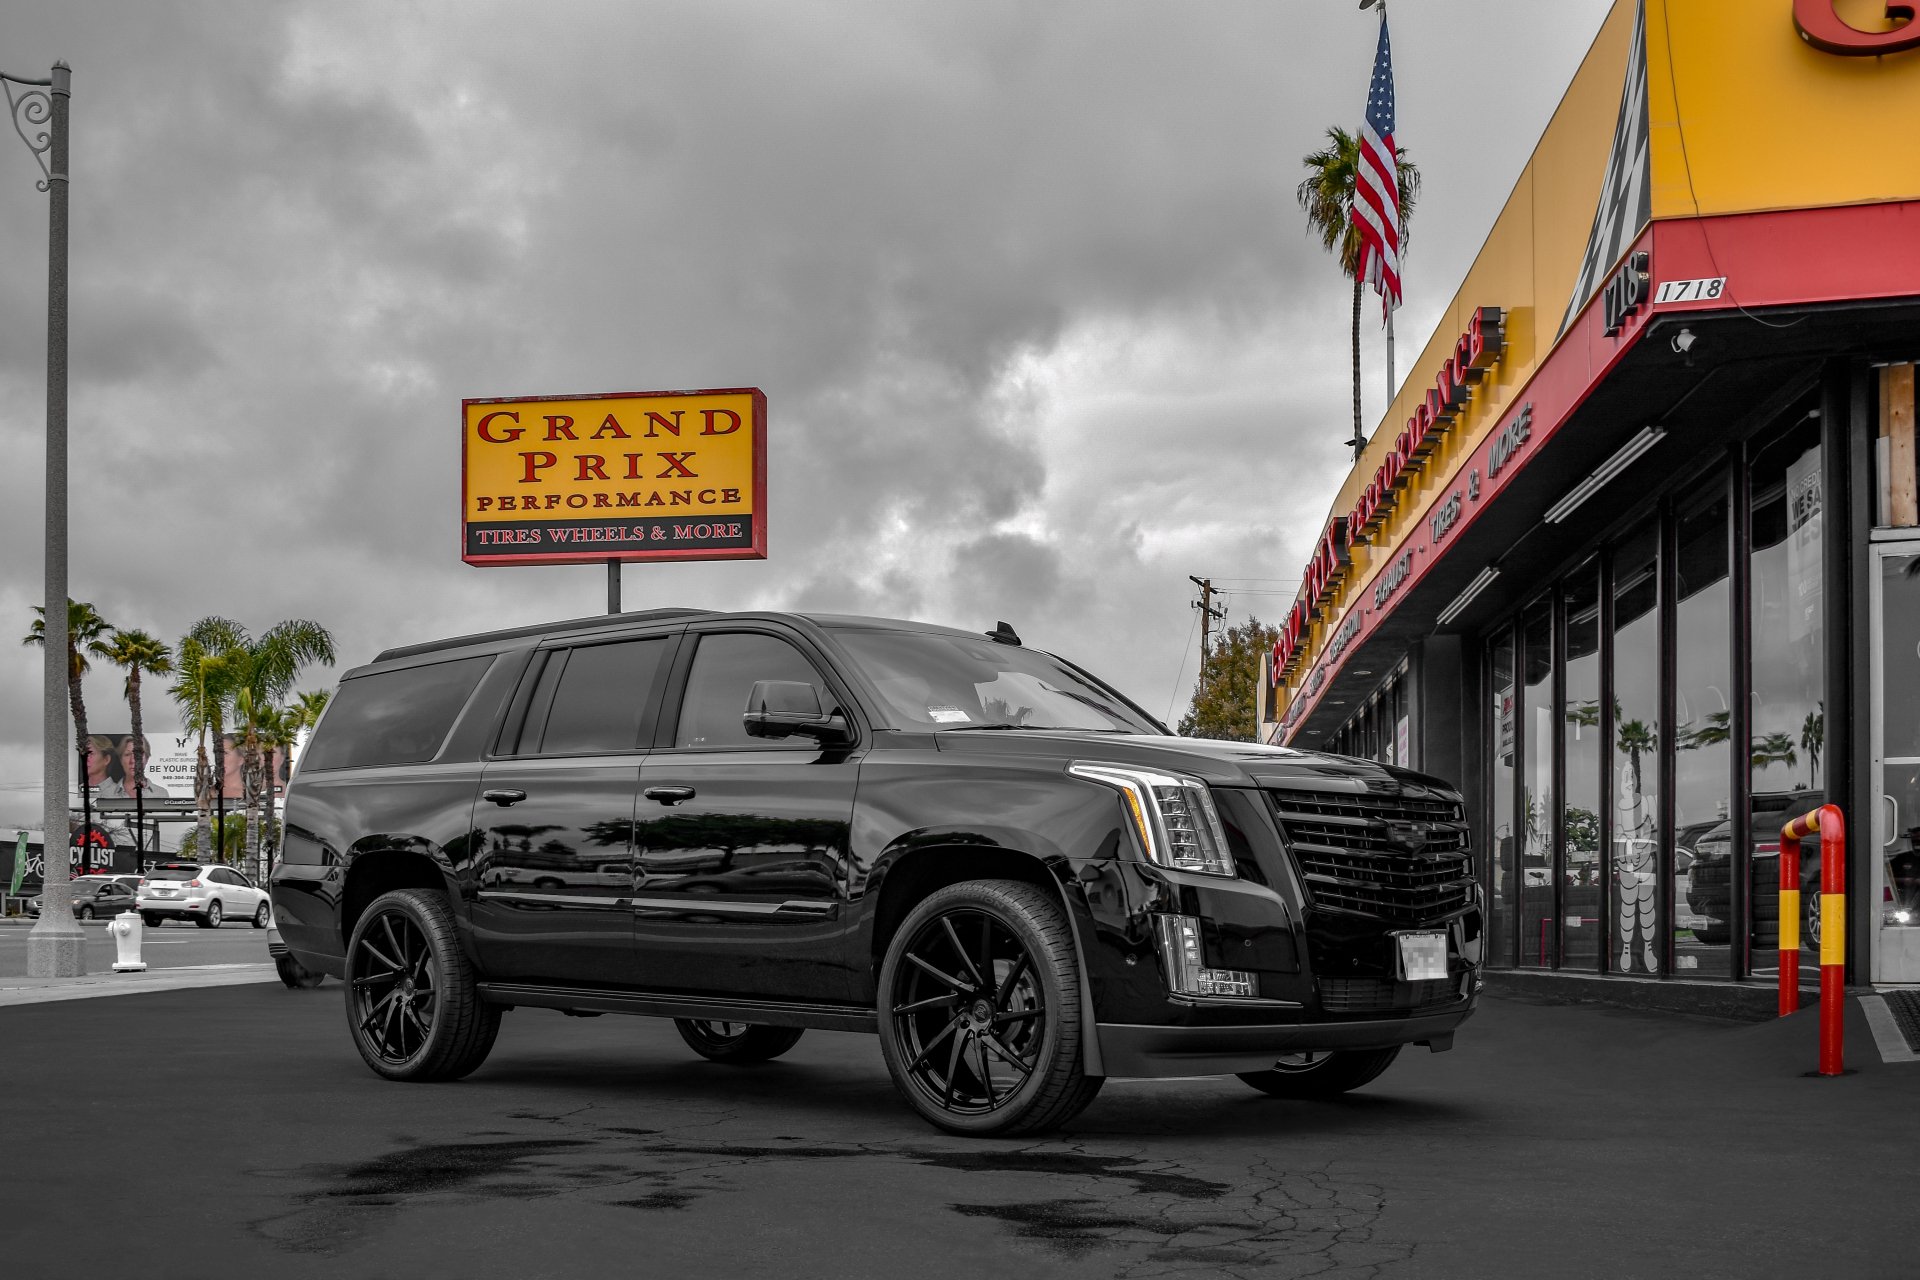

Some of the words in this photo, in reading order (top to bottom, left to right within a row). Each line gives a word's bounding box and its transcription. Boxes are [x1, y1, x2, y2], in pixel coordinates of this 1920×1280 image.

[1661, 279, 1721, 302] 1718
[476, 408, 742, 444] GRAND
[518, 450, 699, 483] PRIX
[1303, 516, 1347, 625] PRIX
[1348, 306, 1500, 547] PERFORMANCE
[476, 488, 742, 512] PERFORMANCE
[1374, 547, 1413, 610] EXHAUST
[1431, 490, 1462, 544] TIRES
[1468, 468, 1480, 501] &
[1488, 402, 1532, 479] MORE
[1792, 495, 1804, 521] WE
[475, 528, 542, 546] TIRES
[546, 525, 645, 544] WHEELS
[650, 525, 667, 541] &
[673, 522, 743, 540] MORE
[150, 765, 161, 773] BE
[163, 765, 188, 773] YOUR
[70, 846, 115, 867] CYLIST
